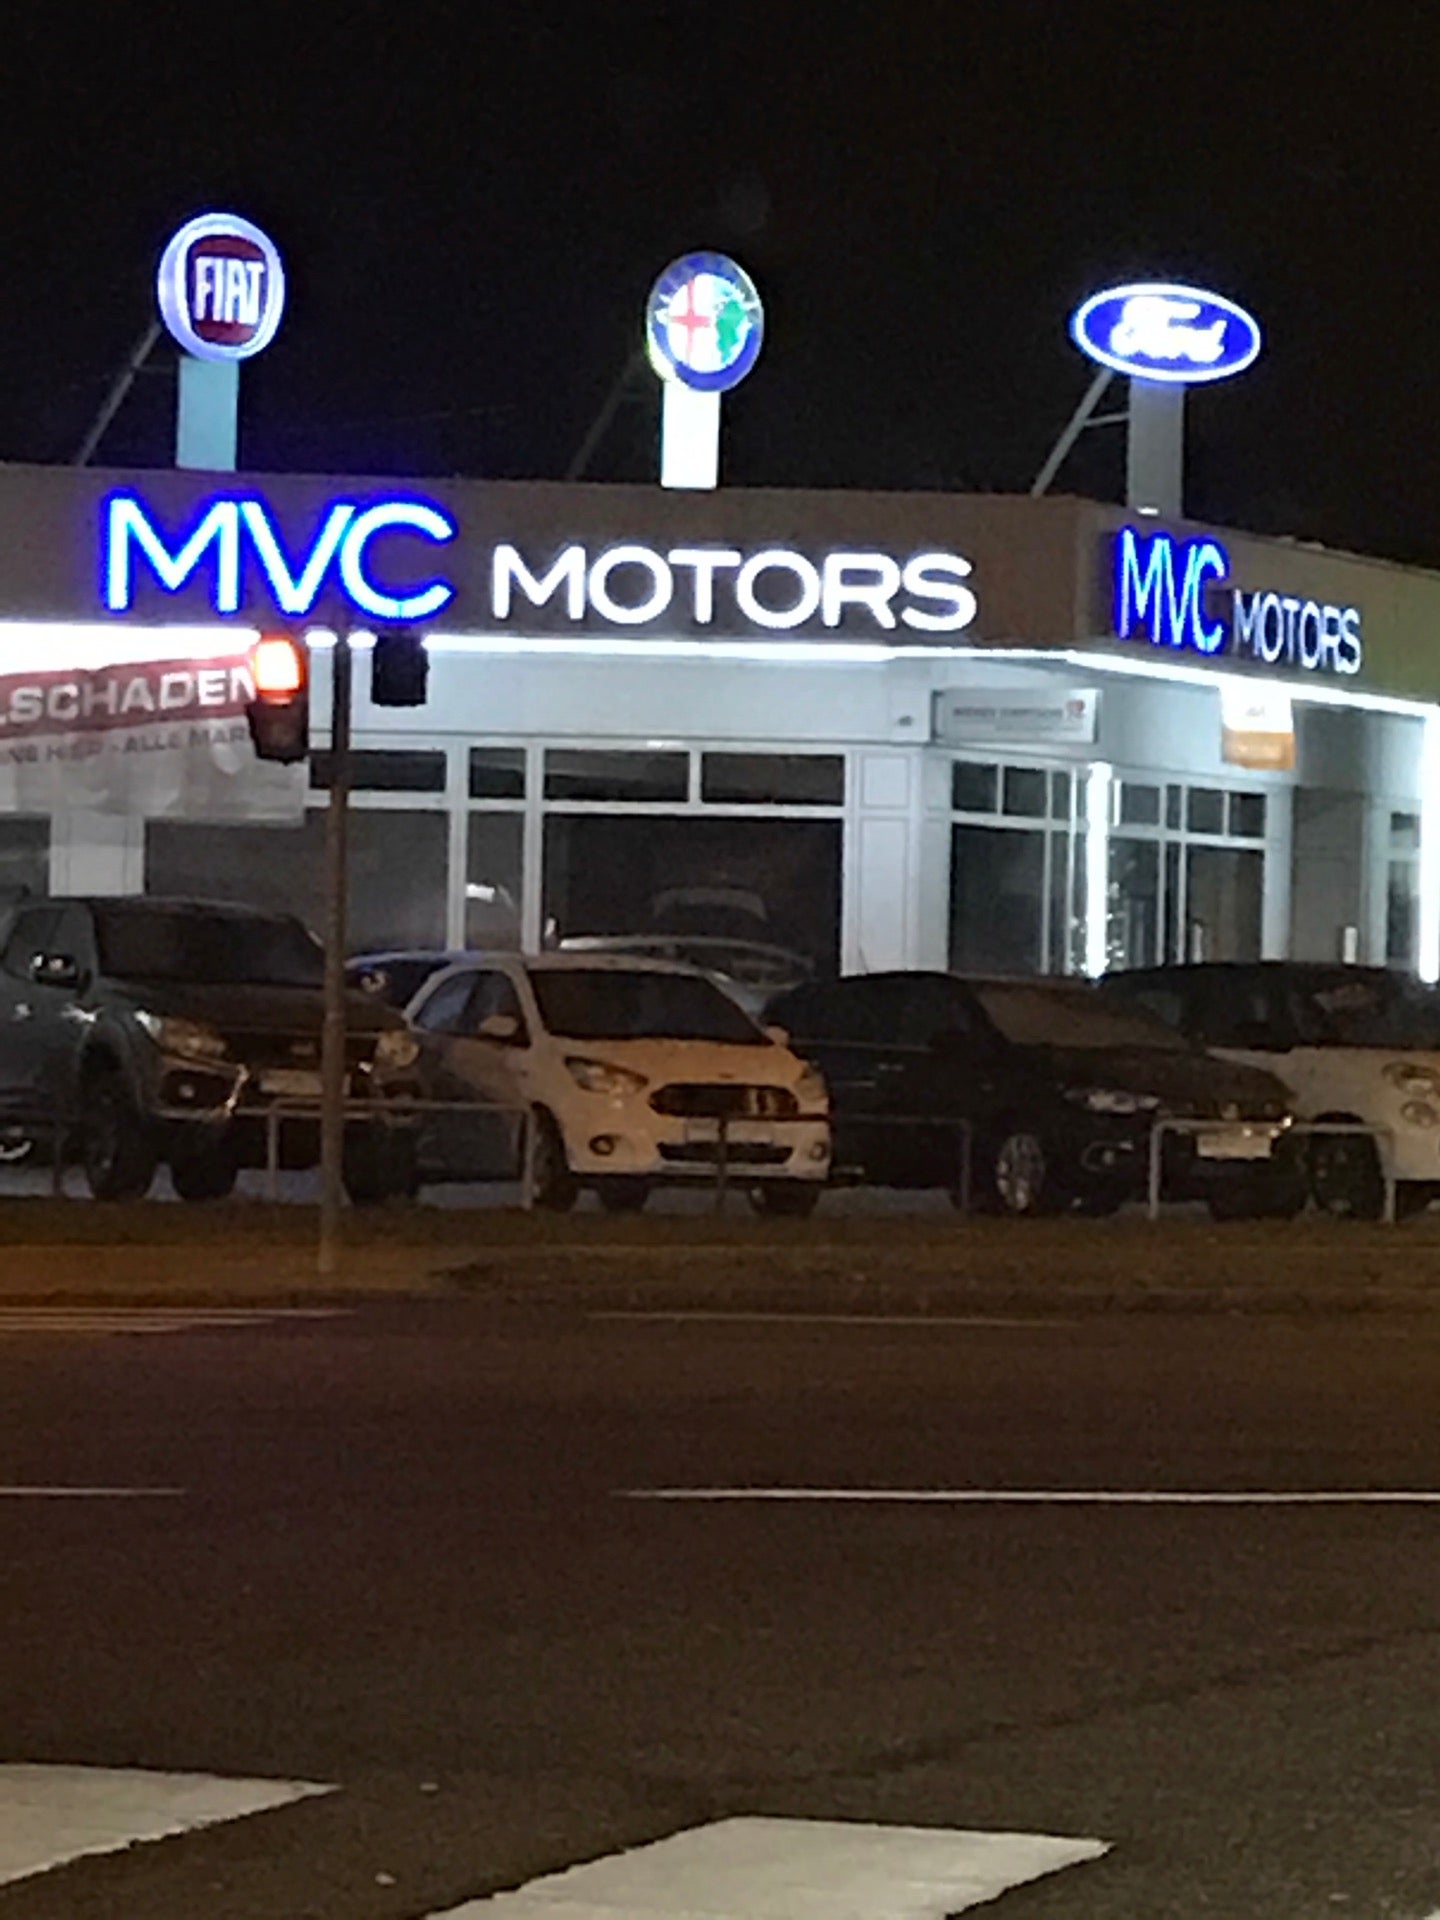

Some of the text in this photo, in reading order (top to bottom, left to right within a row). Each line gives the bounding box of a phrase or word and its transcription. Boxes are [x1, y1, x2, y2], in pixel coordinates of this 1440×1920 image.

[195, 256, 265, 325] FIAT
[1110, 296, 1228, 363] Ford
[106, 497, 978, 632] MVC MOTORS
[1118, 528, 1363, 675] MVC MOTORS
